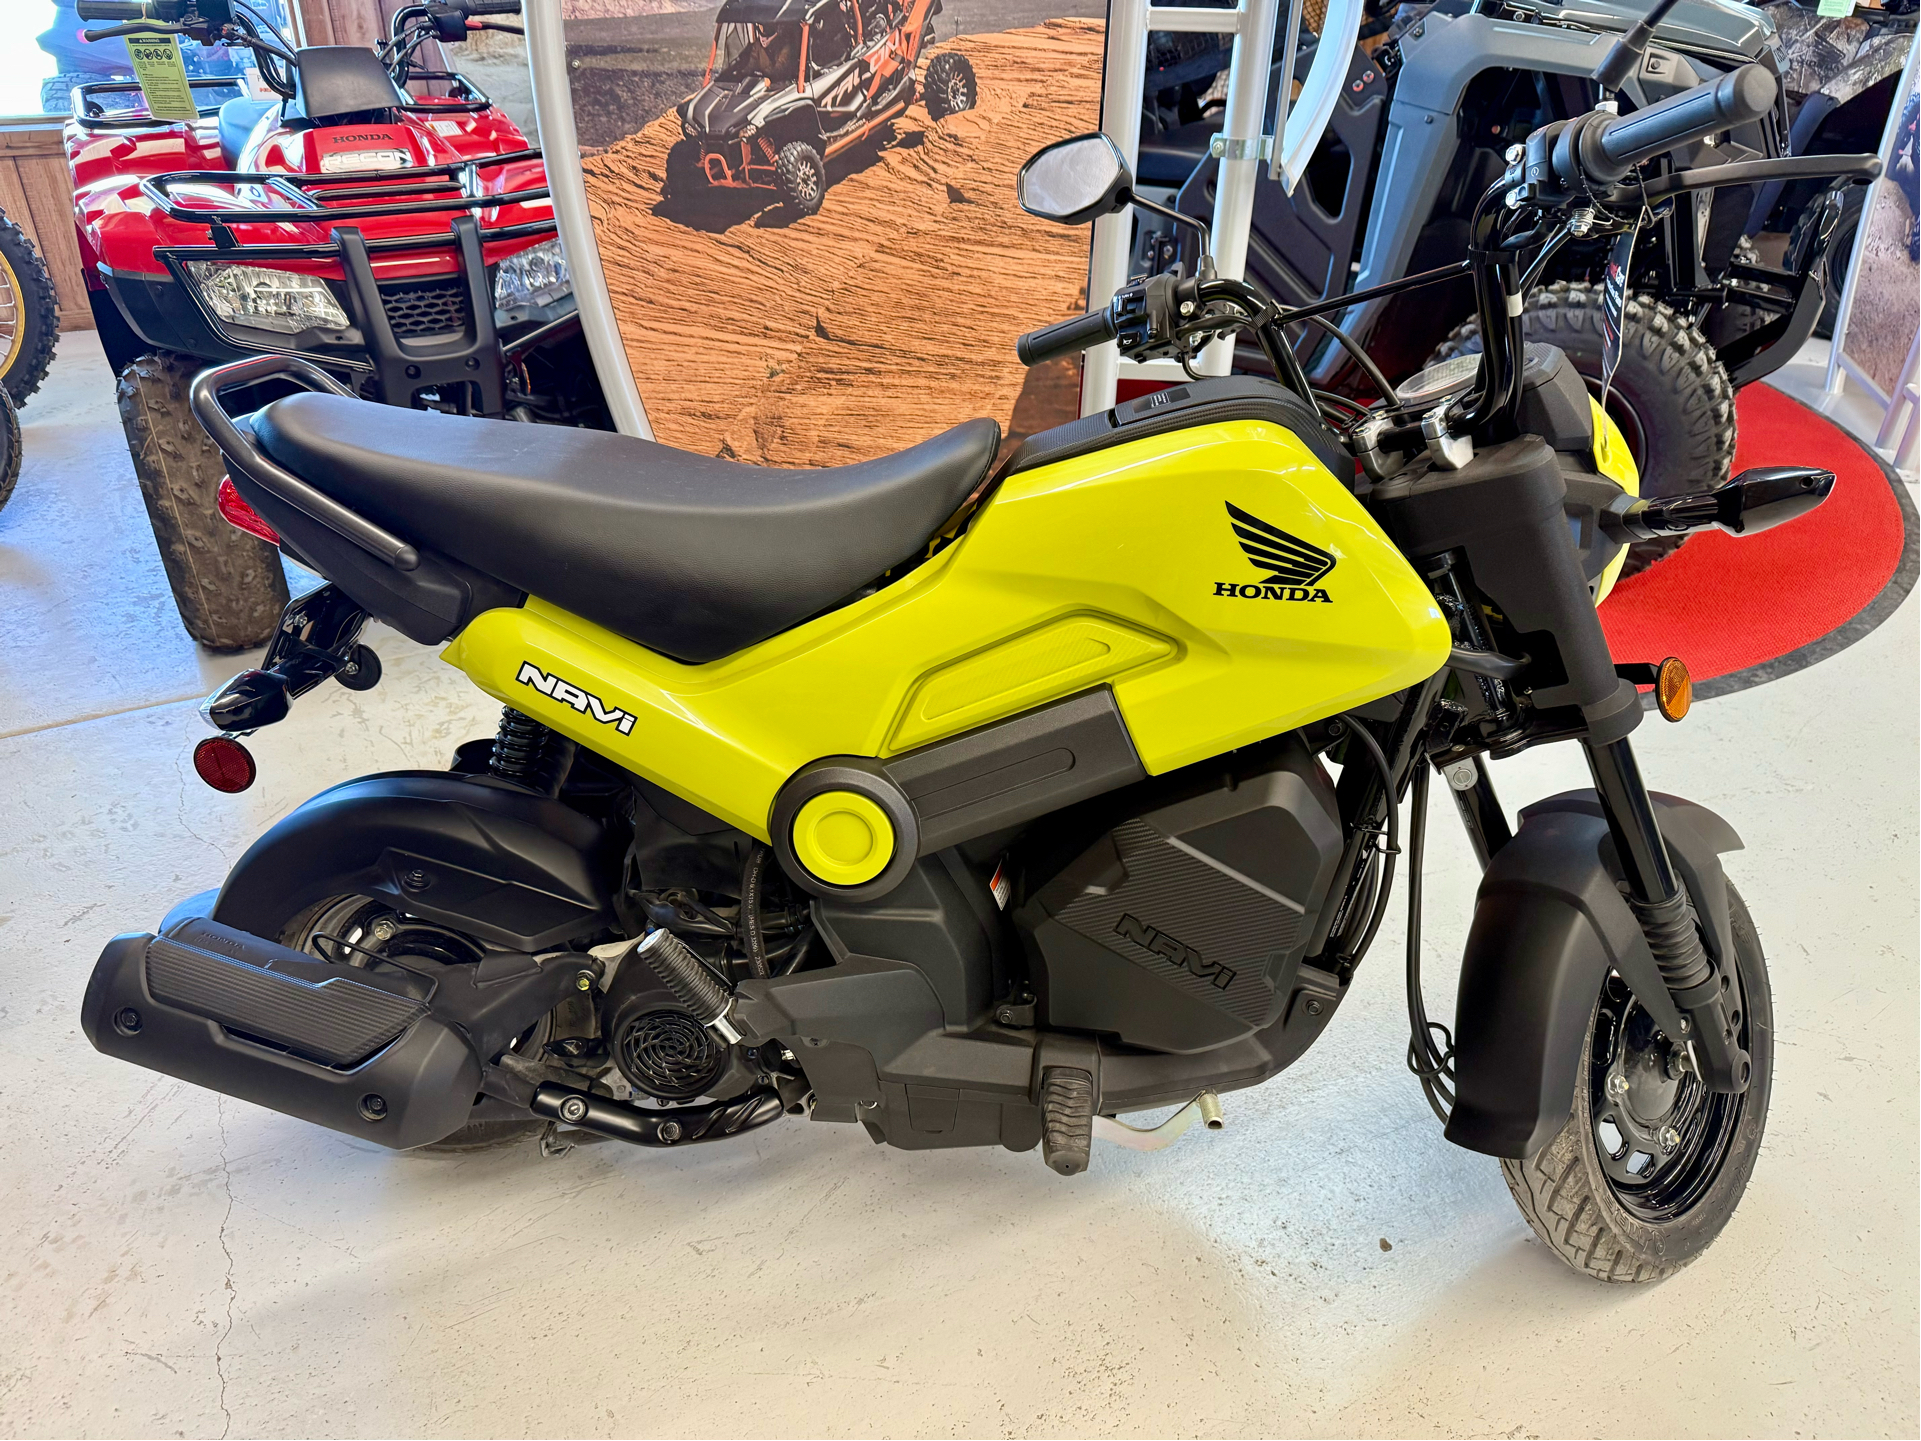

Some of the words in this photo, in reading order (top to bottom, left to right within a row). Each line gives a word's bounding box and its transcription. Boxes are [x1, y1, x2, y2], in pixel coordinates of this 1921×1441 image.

[821, 27, 900, 111] TALON
[332, 133, 394, 144] HONDA
[323, 150, 413, 167] RECON
[1212, 581, 1334, 604] HONDA
